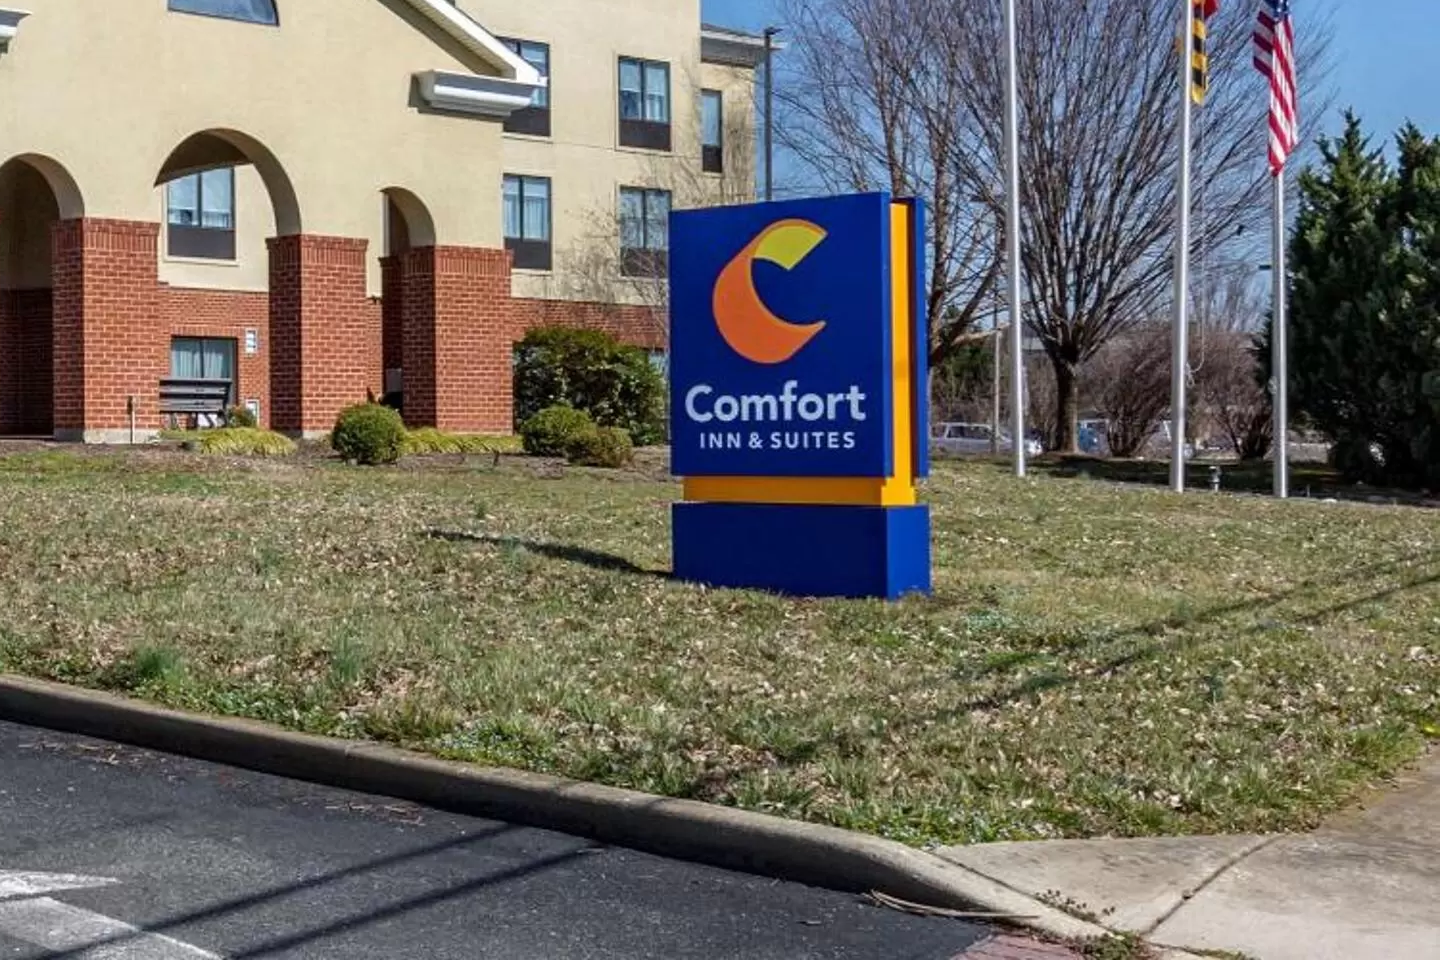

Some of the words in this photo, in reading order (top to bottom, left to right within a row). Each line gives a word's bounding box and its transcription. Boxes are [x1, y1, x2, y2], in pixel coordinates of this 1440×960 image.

[685, 380, 867, 422] Comfort
[700, 432, 742, 449] INN
[748, 432, 763, 449] &
[770, 431, 856, 449] SUITES
